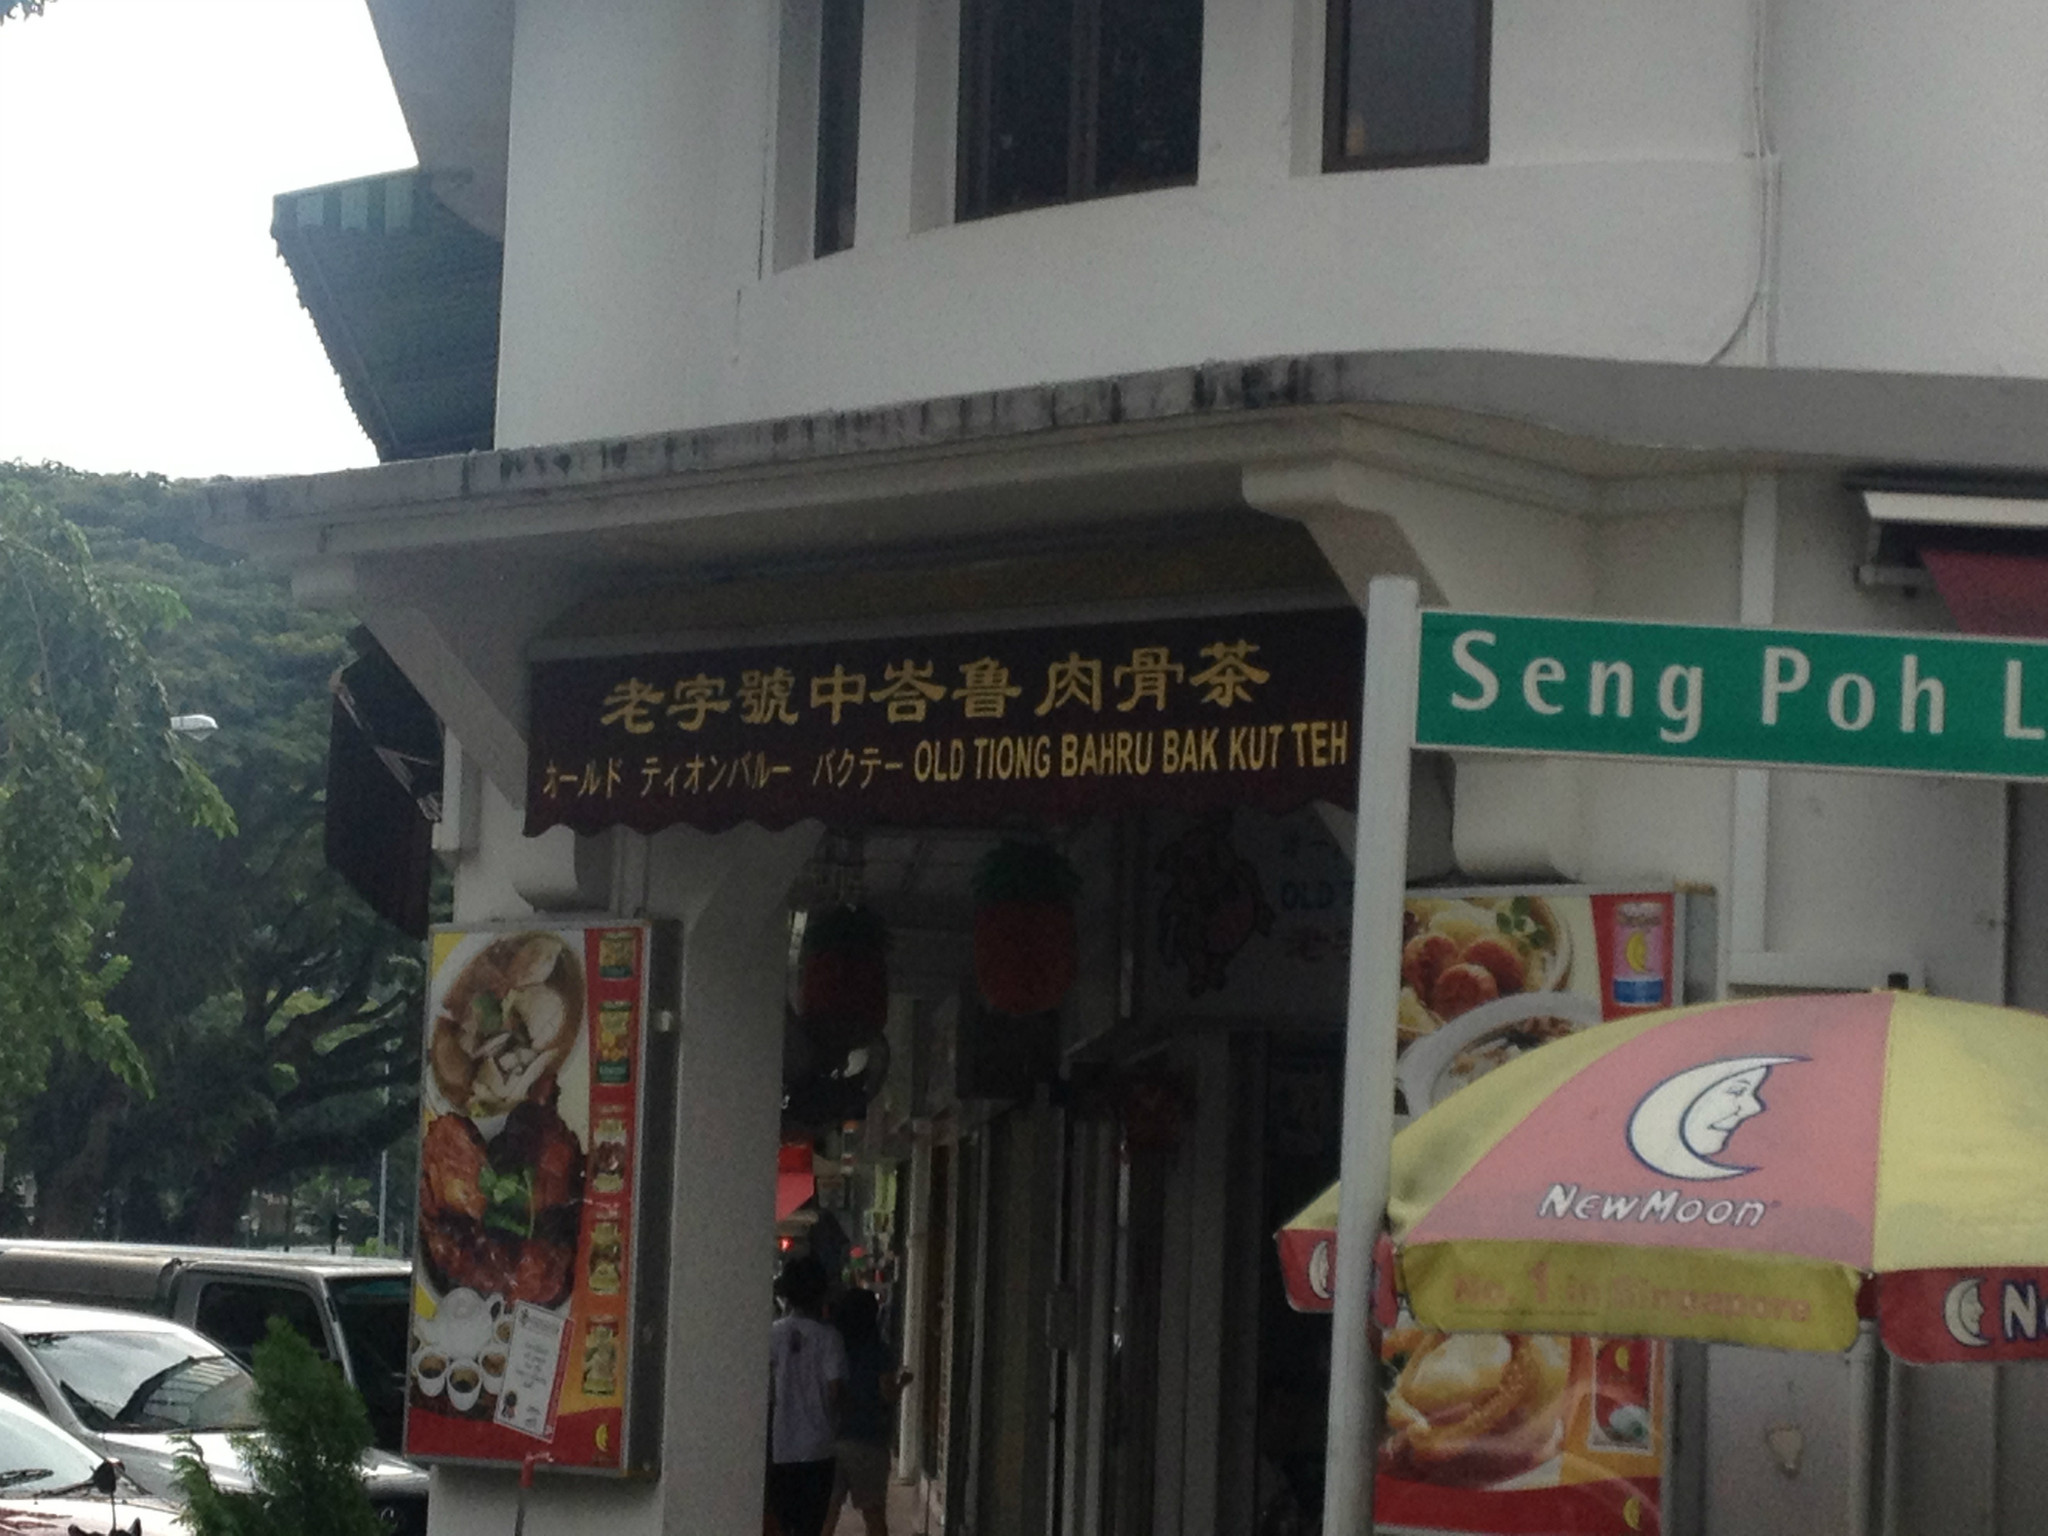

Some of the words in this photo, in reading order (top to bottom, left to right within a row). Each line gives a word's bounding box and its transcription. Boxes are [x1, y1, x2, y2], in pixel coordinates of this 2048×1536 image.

[1450, 629, 1704, 743] Seng
[1761, 646, 1946, 735] Poh
[2004, 659, 2046, 739] L
[914, 739, 964, 782] OLD
[974, 735, 1050, 780] TIONG
[1060, 731, 1153, 778] BAHRU
[1162, 728, 1218, 774] BAK
[1228, 724, 1283, 771] KUT
[1291, 720, 1349, 768] TEH
[2002, 1280, 2048, 1341] N
